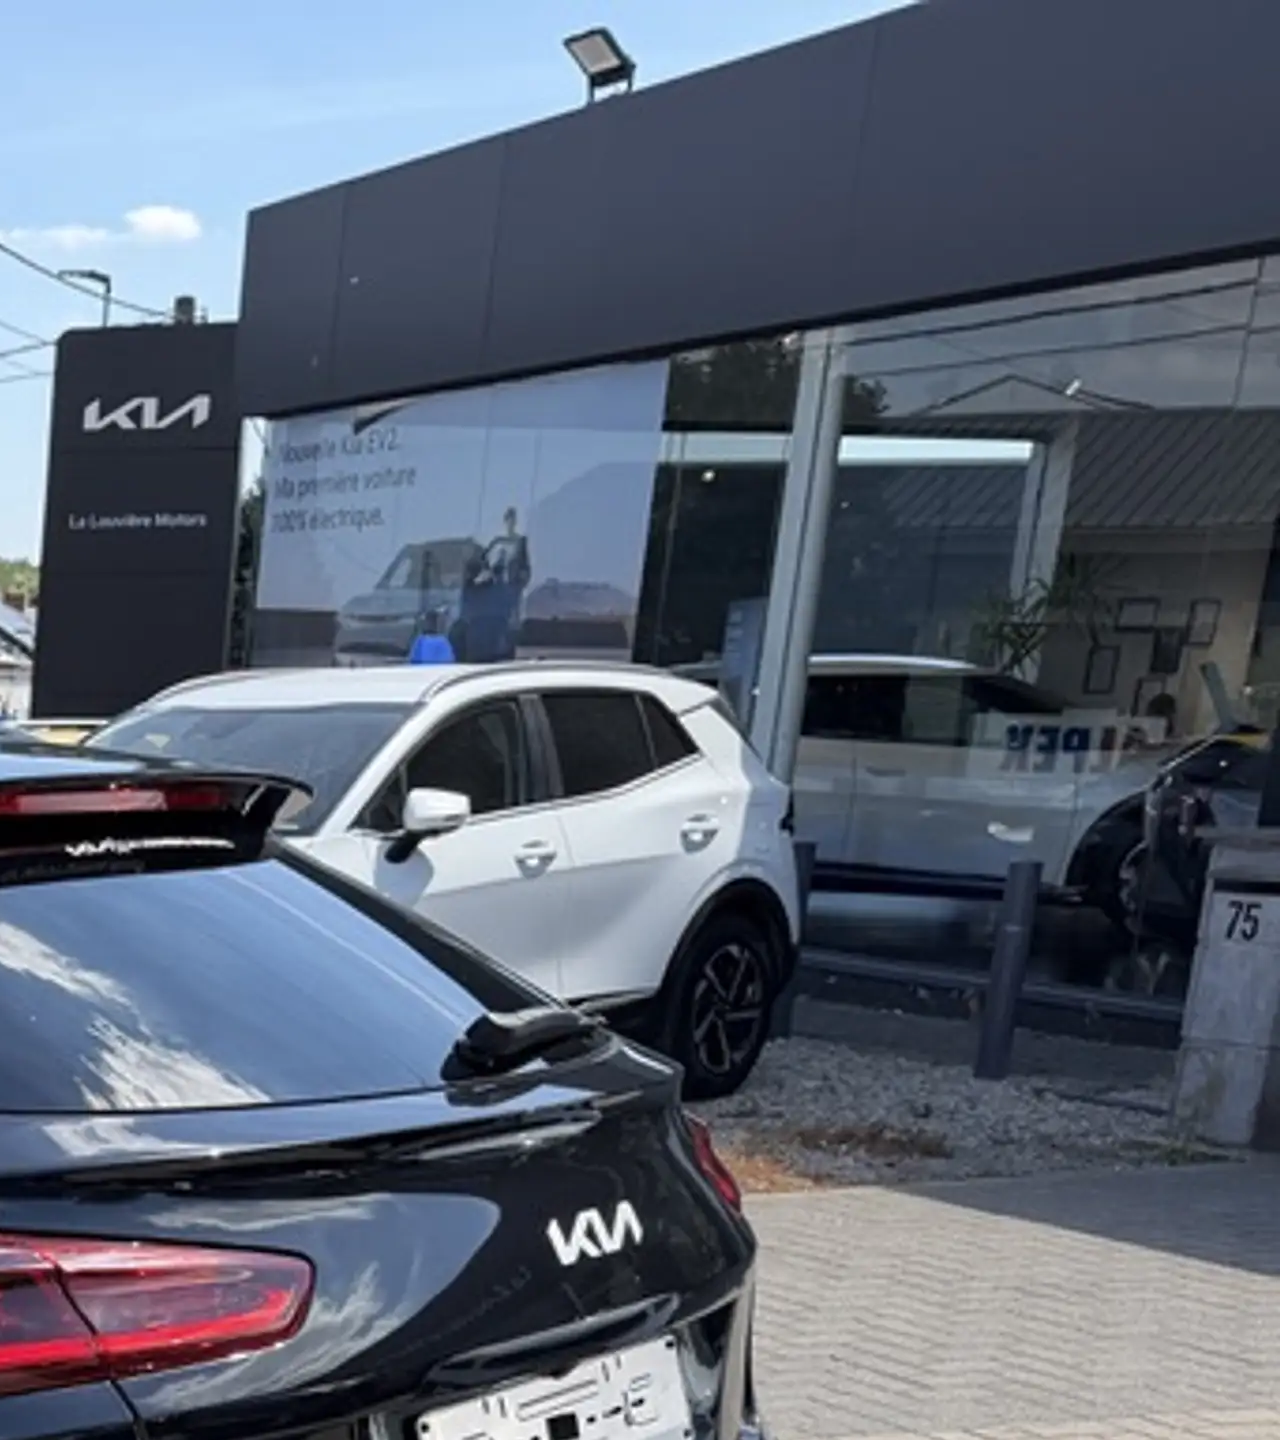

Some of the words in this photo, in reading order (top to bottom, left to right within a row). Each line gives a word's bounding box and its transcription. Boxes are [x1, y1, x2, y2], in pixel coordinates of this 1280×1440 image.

[83, 392, 211, 432] KIA
[363, 465, 417, 490] voiture
[68, 512, 86, 530] La
[154, 511, 207, 528] Motors
[1225, 900, 1263, 941] 75
[546, 1200, 644, 1266] KIA
